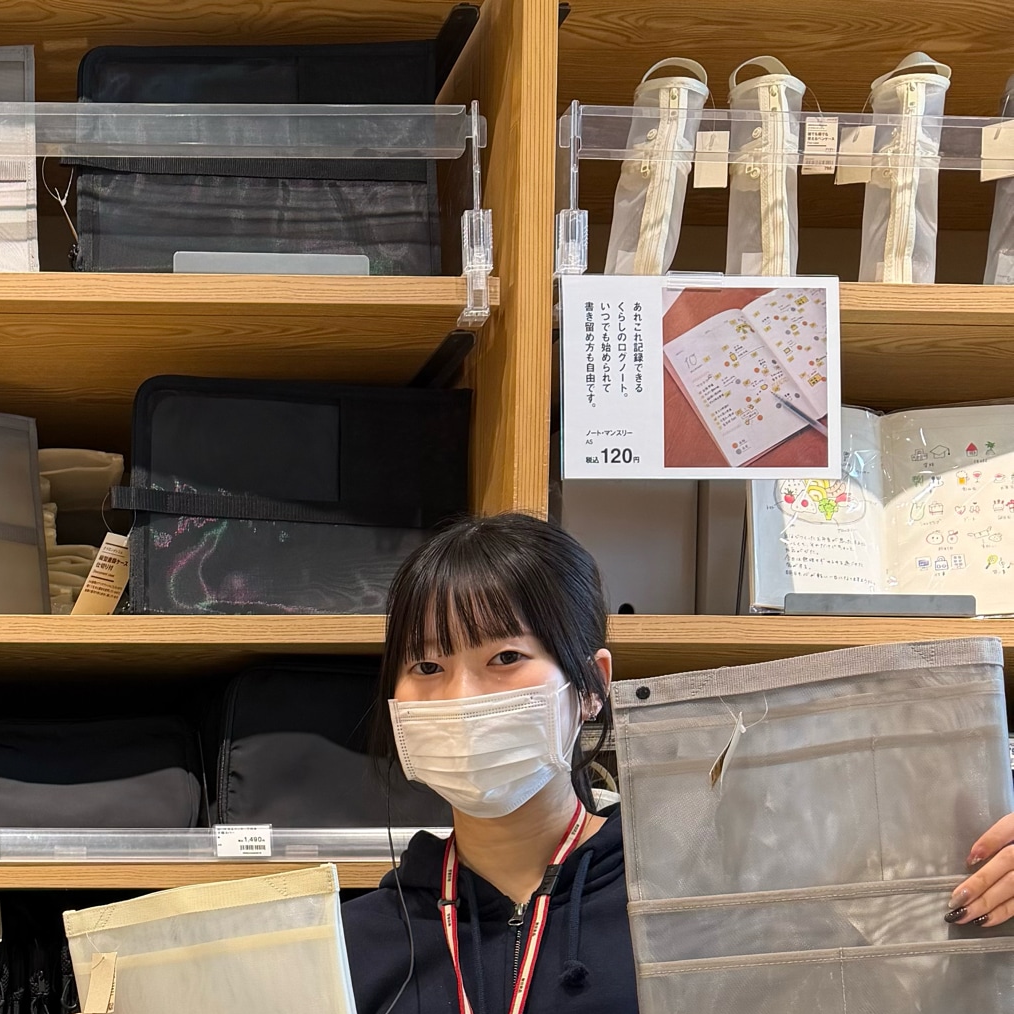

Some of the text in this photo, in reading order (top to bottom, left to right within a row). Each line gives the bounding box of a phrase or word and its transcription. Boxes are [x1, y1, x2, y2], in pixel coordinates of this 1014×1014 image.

[585, 302, 596, 407] 書き留め方も自由です。
[600, 303, 611, 393] いつでも始められて
[617, 302, 628, 397] くらしのログノート。
[633, 302, 643, 393] あれこれ記録できる
